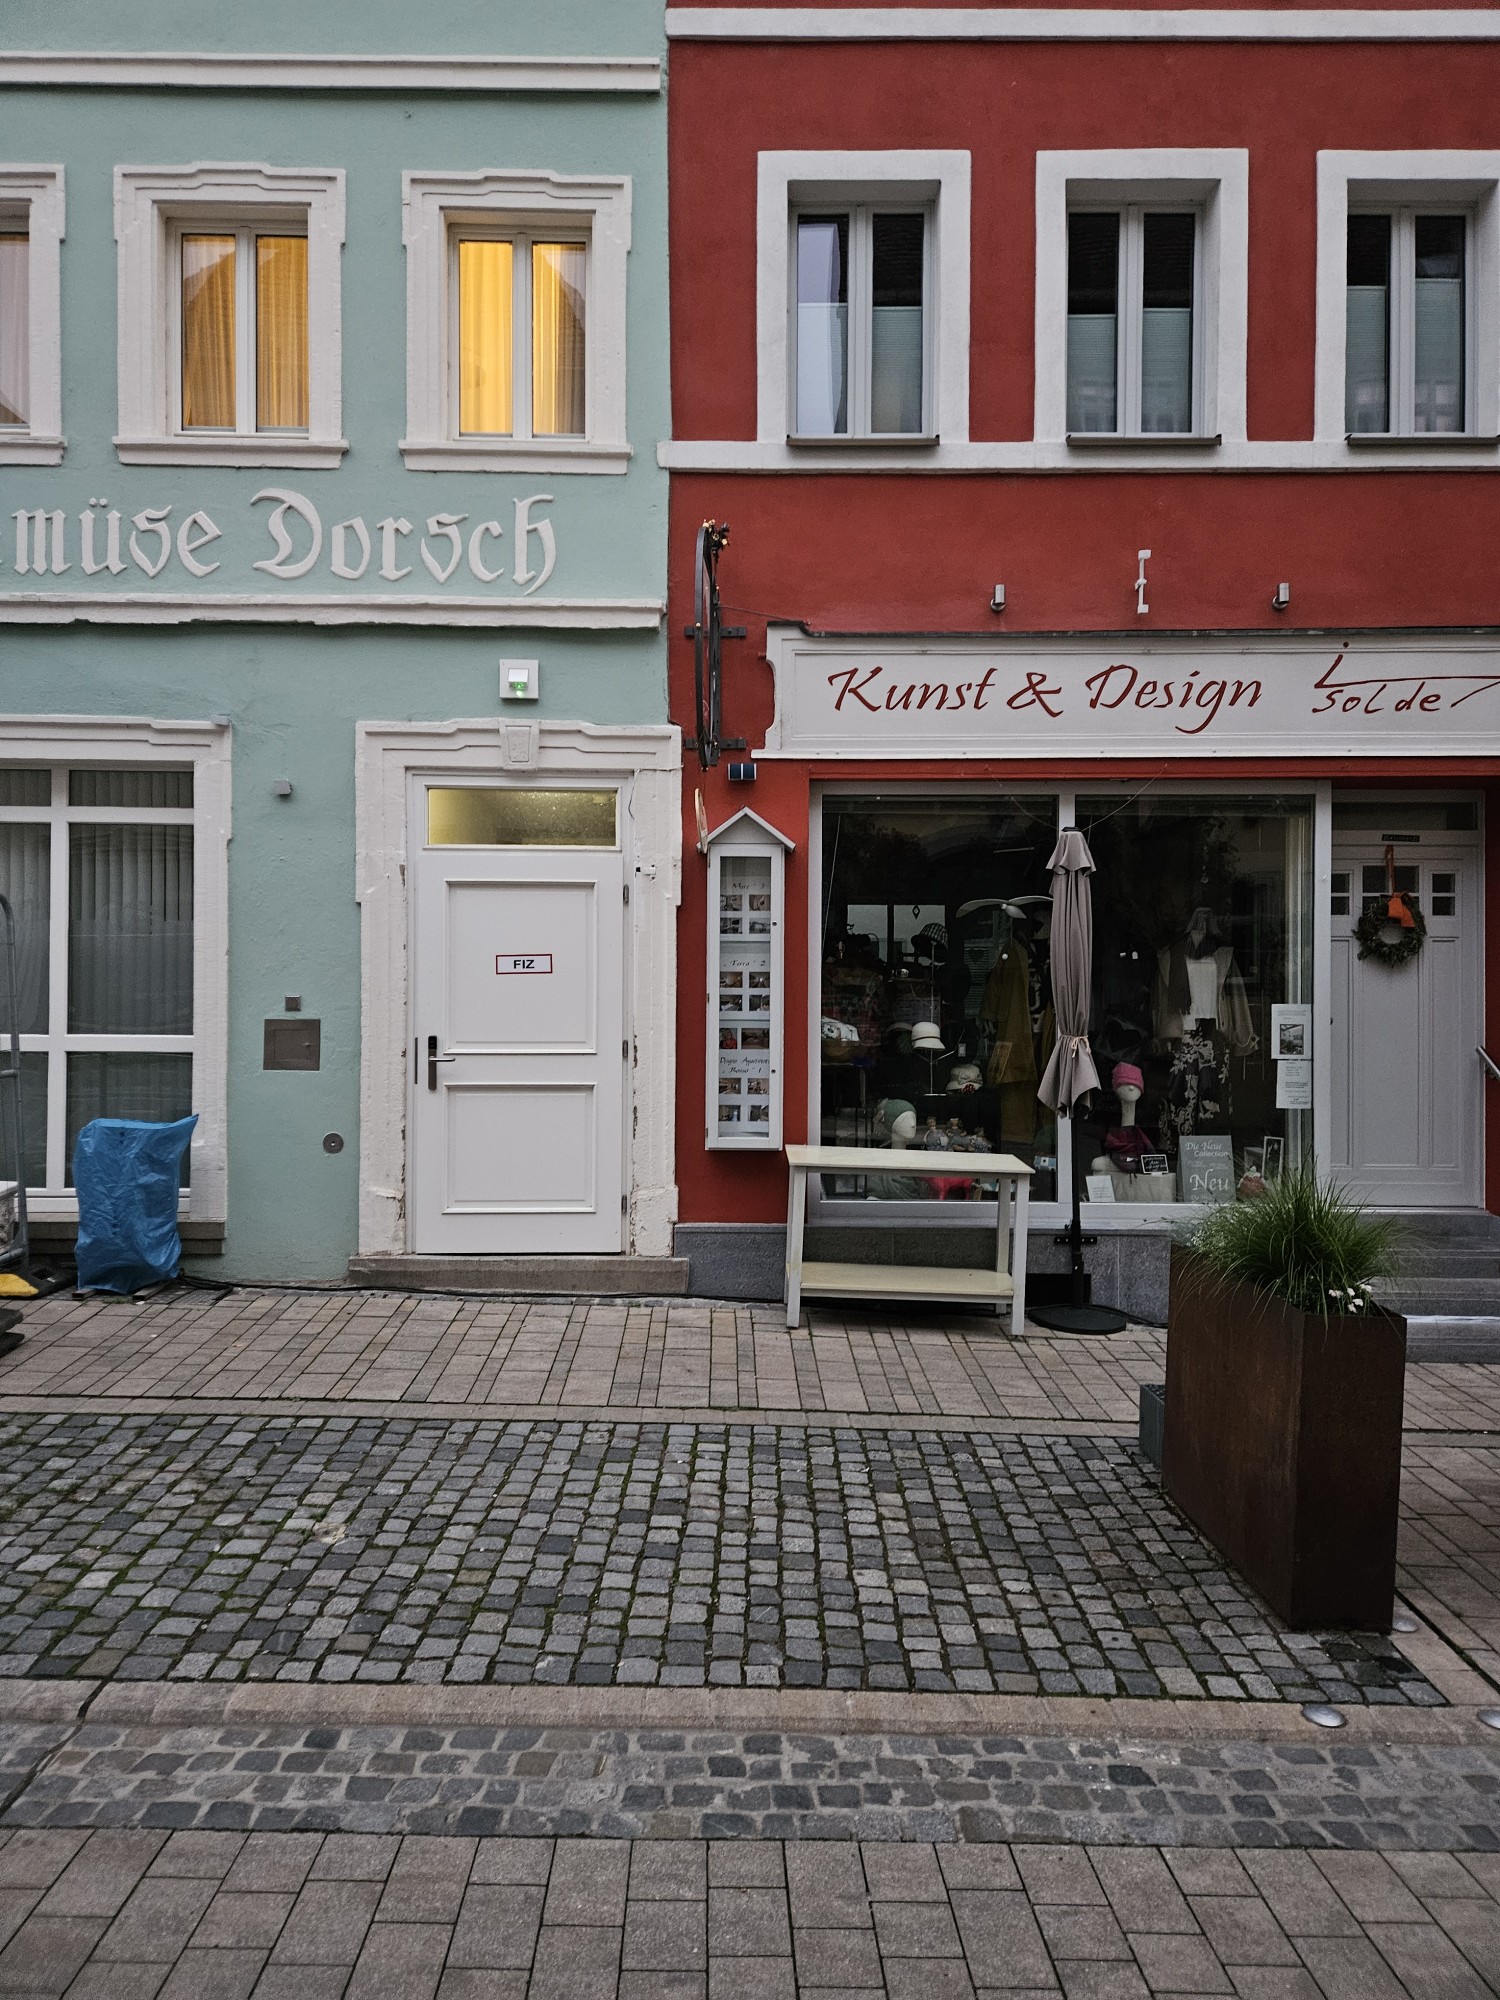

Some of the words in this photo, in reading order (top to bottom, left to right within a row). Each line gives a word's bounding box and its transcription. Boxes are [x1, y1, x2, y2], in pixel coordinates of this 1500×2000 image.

[0, 497, 222, 579] müse
[250, 487, 557, 595] Dorsch
[828, 666, 995, 712] Kunst
[1007, 671, 1063, 717] &
[1085, 664, 1262, 734] Design
[513, 959, 535, 969] FIZ
[1189, 1168, 1231, 1192] Neu
